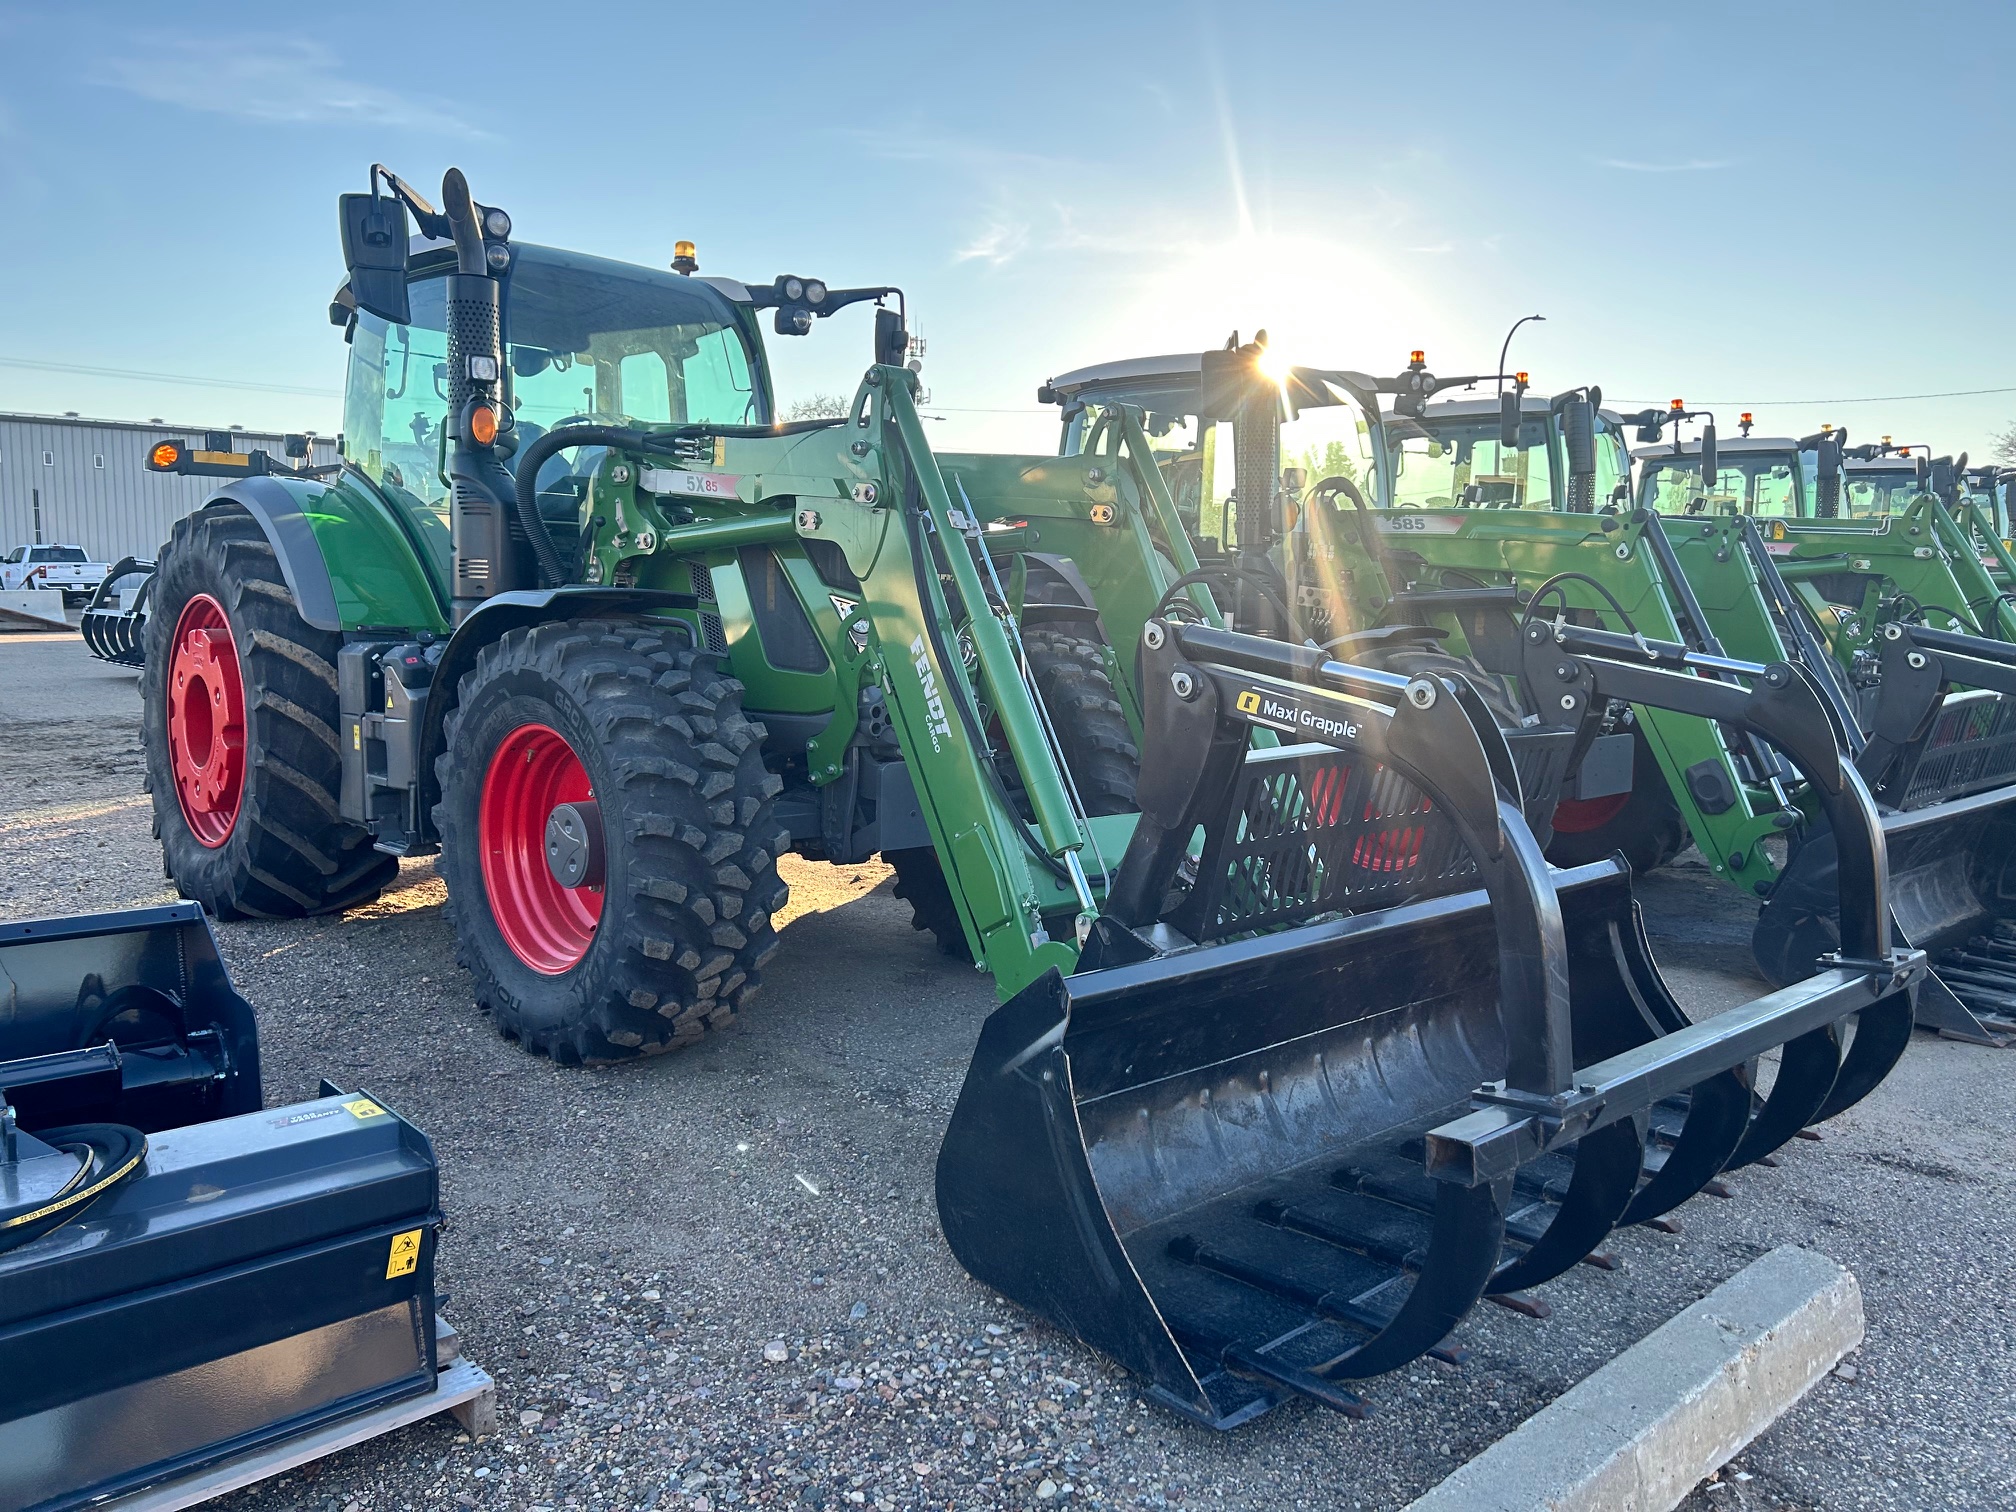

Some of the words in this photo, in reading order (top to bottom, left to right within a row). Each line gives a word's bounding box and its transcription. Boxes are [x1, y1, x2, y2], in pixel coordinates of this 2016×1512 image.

[1391, 518, 1425, 530] 585
[910, 634, 952, 738] FENDT
[1263, 699, 1299, 722] Maxi
[925, 714, 941, 754] CARGO
